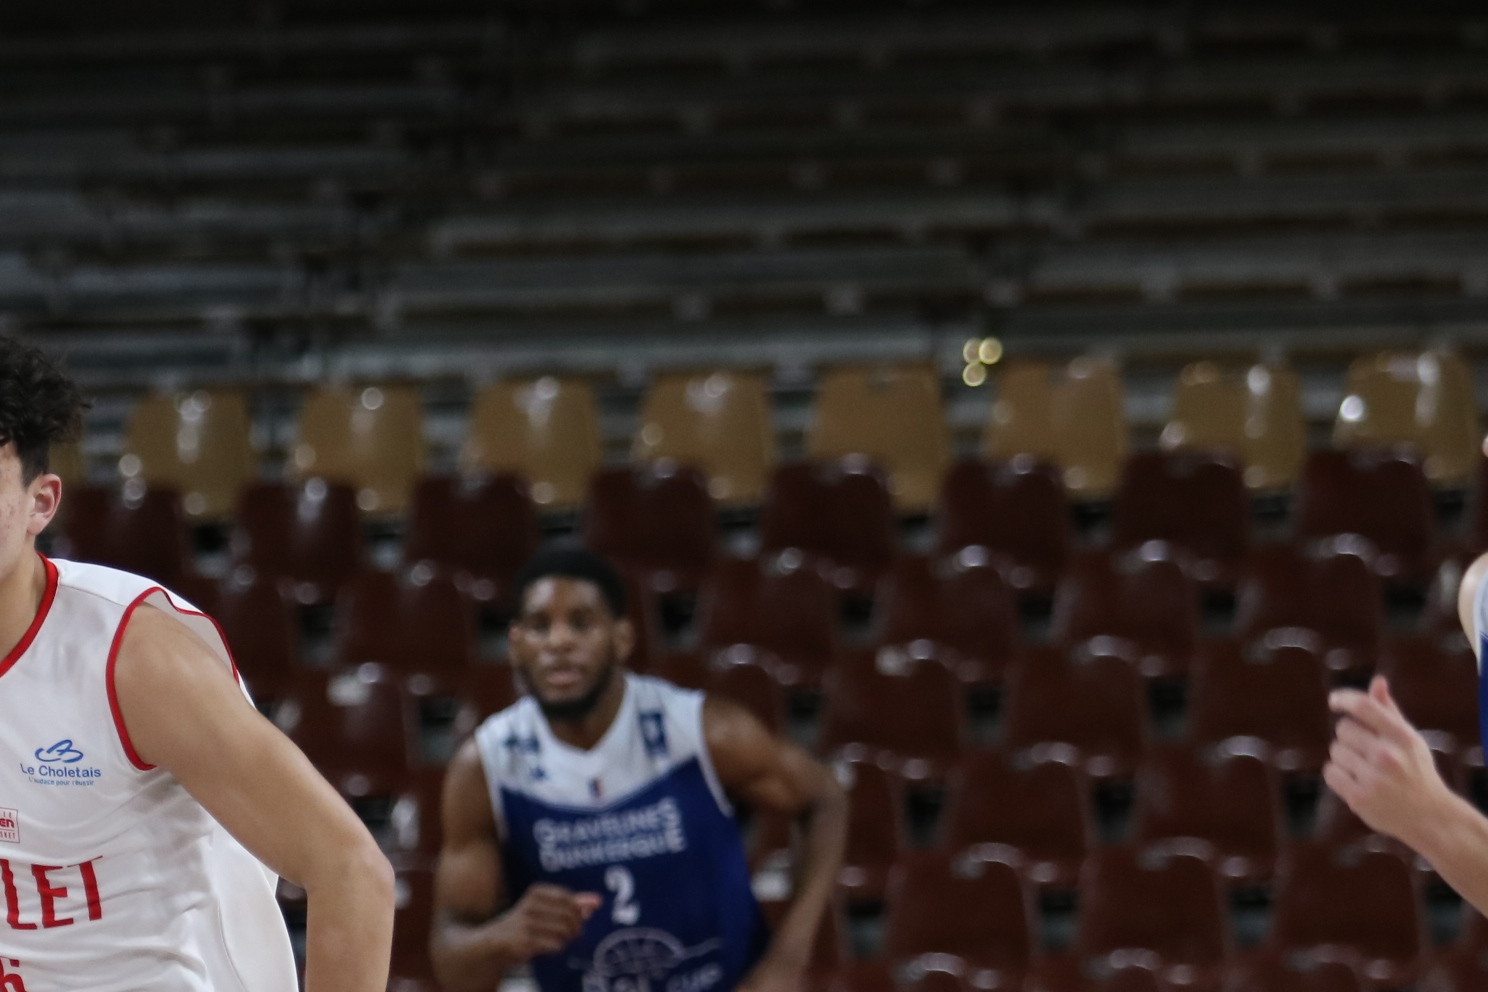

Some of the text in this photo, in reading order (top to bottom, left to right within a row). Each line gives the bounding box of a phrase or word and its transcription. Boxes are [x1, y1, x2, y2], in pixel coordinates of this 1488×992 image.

[20, 763, 101, 778] Le Choletais
[604, 866, 639, 925] 2
